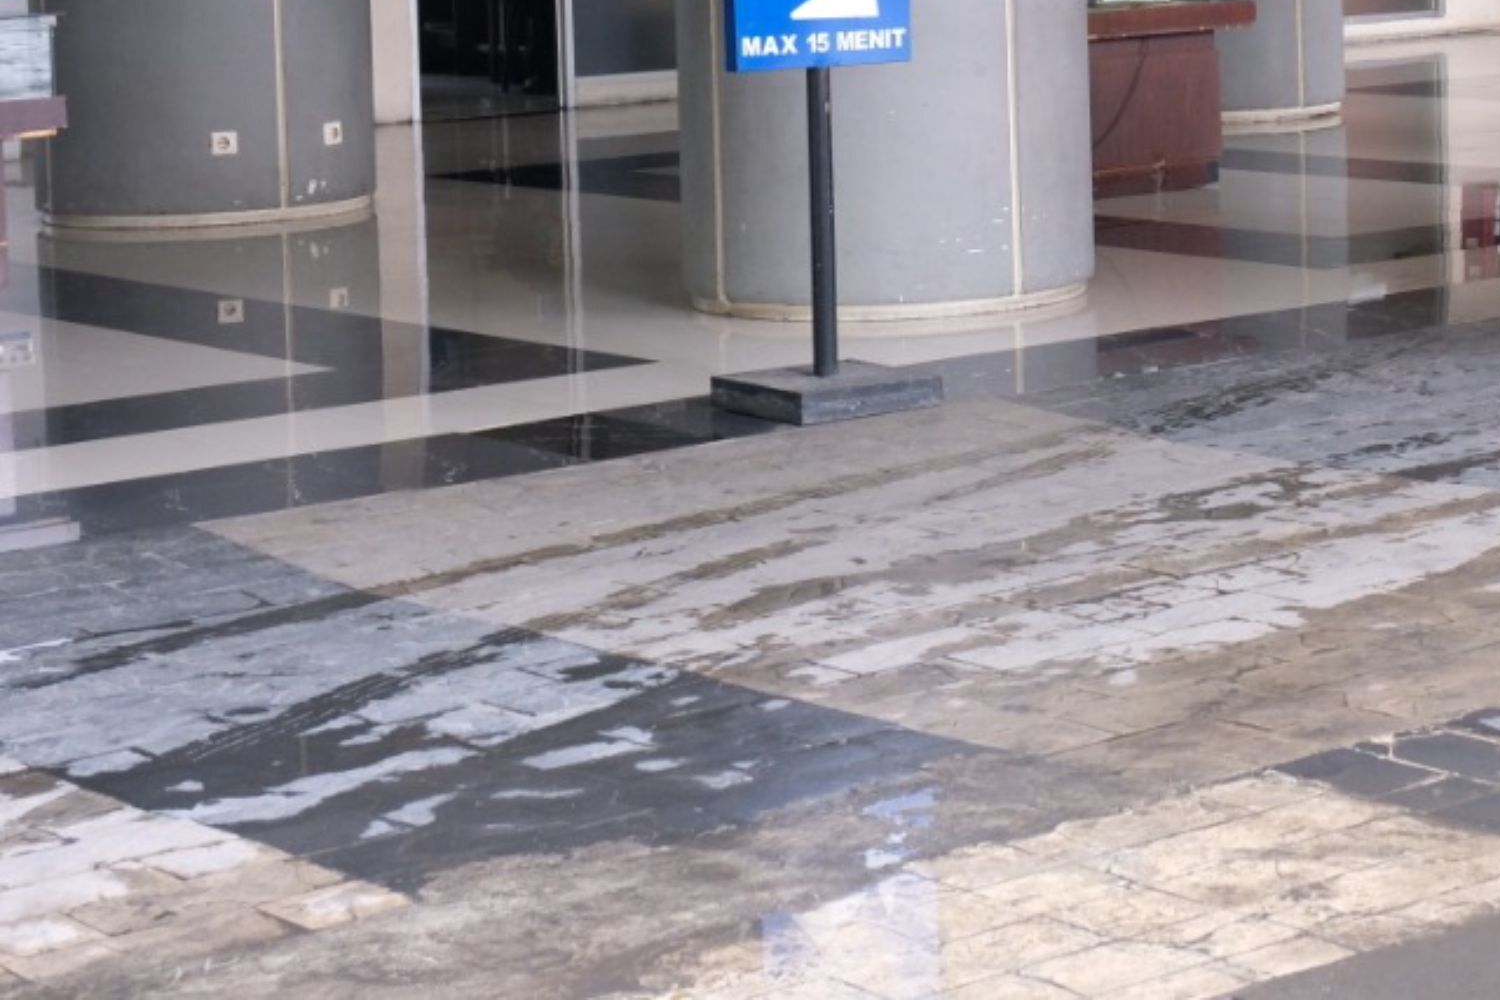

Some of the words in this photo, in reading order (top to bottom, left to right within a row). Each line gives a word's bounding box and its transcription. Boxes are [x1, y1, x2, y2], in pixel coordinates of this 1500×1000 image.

[741, 33, 798, 58] MAX
[806, 31, 830, 53] 15
[836, 27, 907, 52] MENIT
